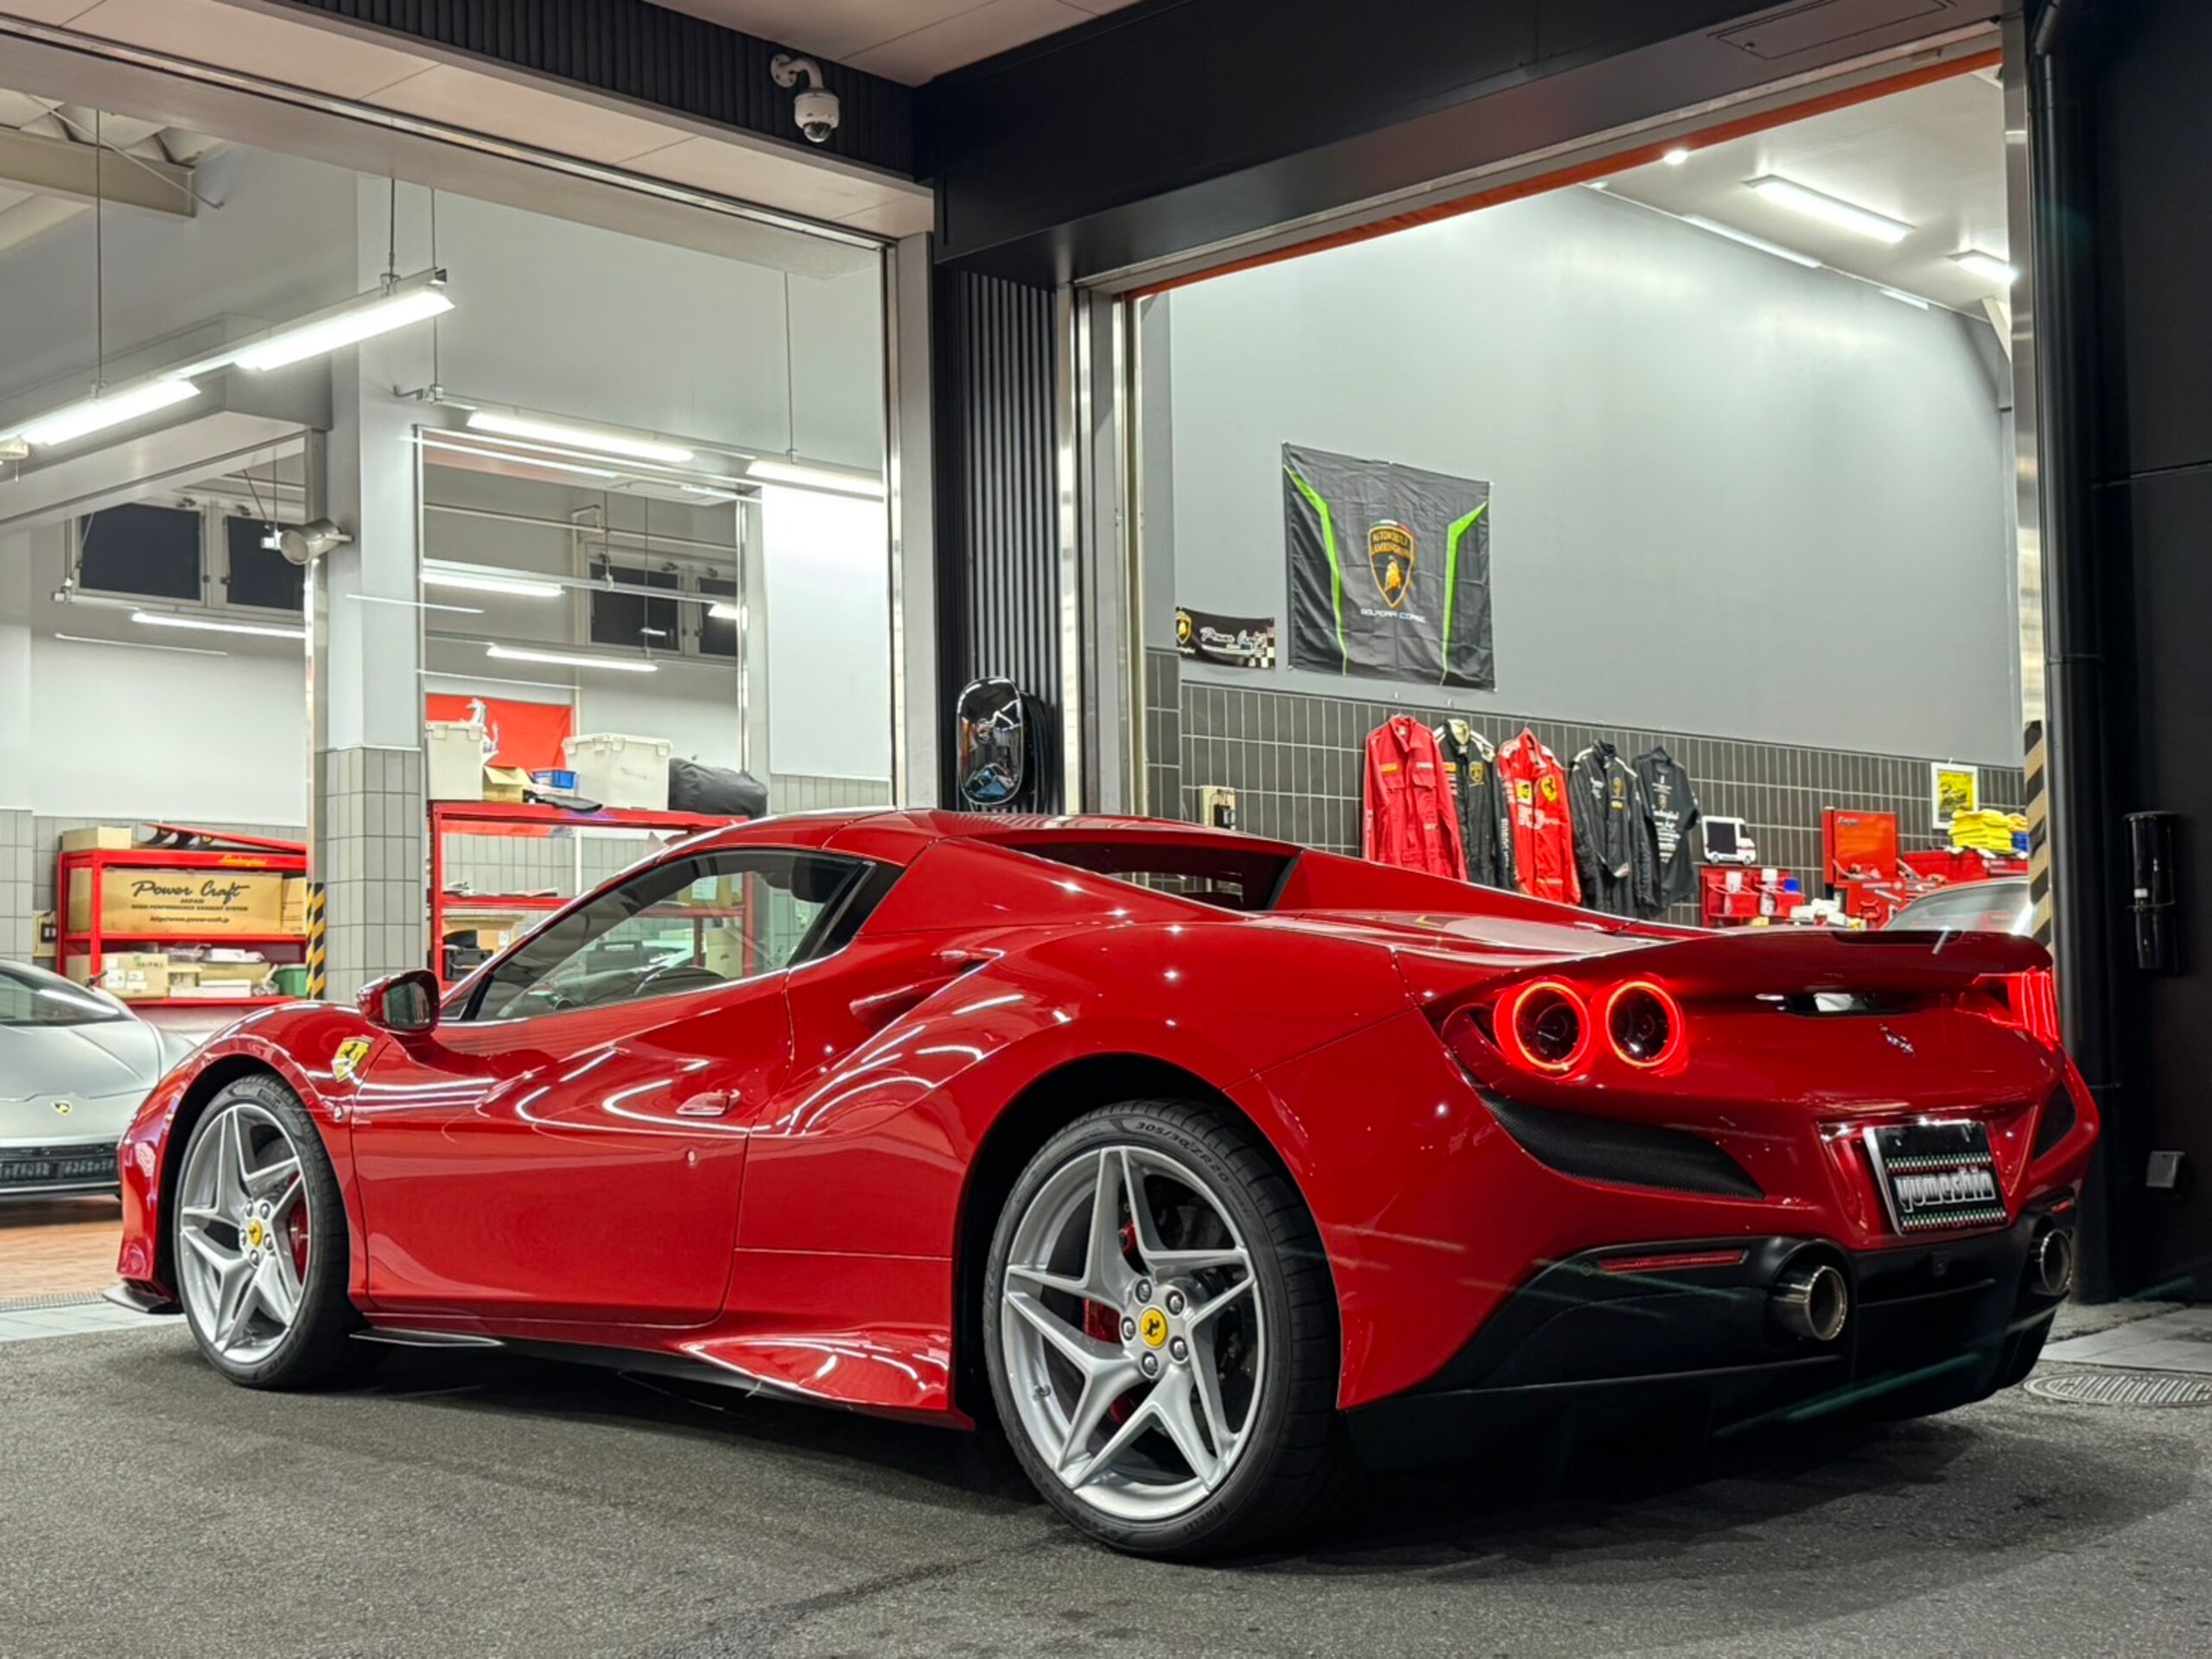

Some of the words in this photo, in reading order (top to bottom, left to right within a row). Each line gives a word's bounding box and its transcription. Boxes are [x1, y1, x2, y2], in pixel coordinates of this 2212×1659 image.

[131, 880, 193, 897] Power
[200, 879, 251, 906] Craft
[1894, 1165, 1996, 1212] yumeshin
